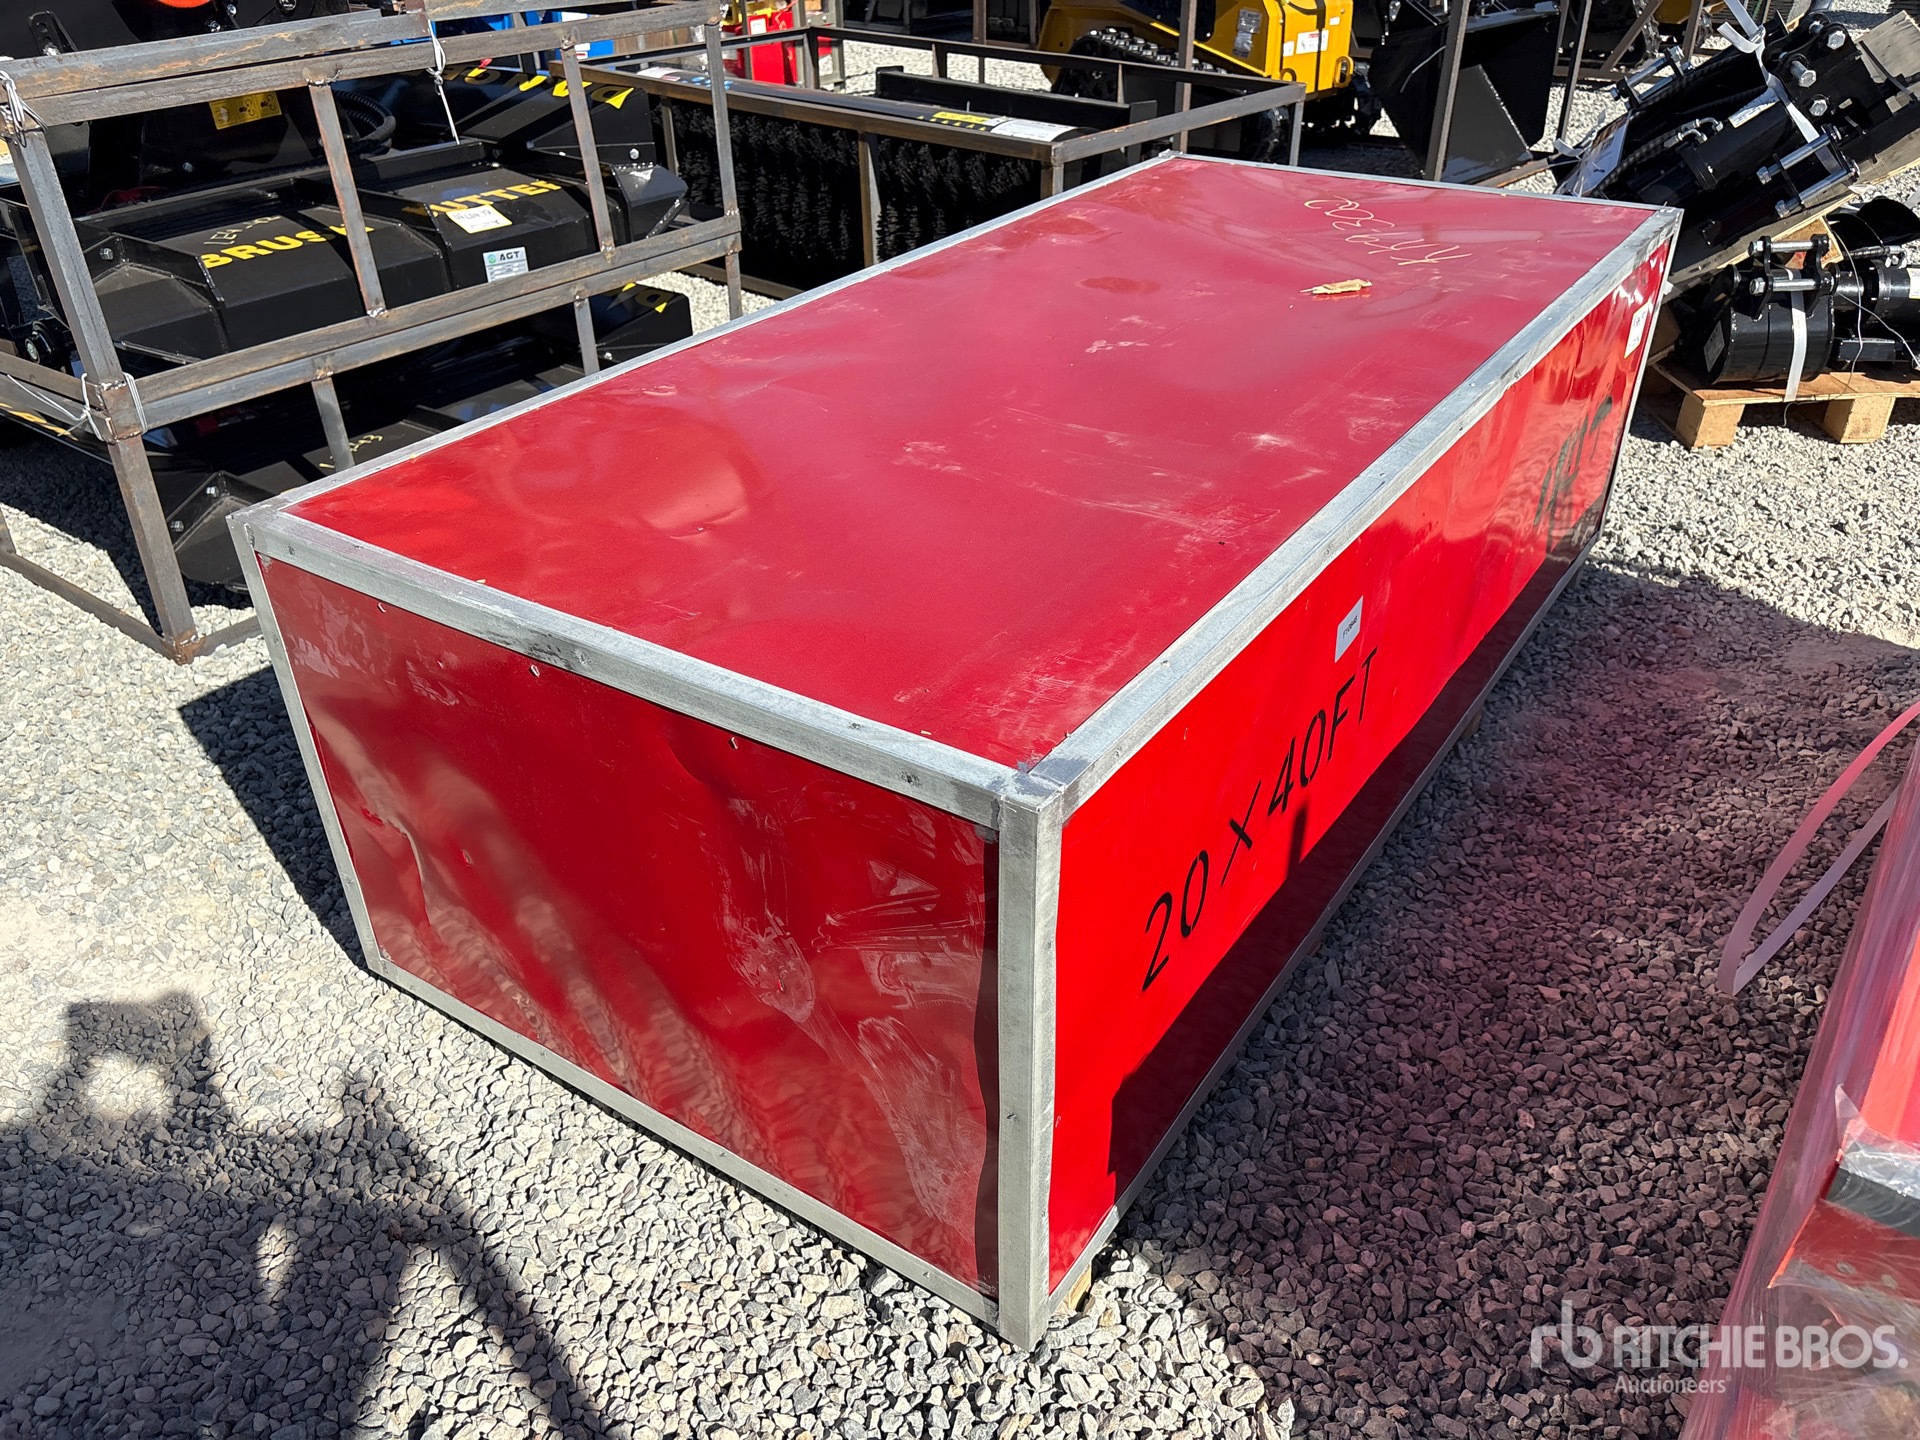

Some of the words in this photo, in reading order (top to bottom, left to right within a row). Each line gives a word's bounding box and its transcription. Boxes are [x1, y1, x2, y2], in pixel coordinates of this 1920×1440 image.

[499, 250, 521, 262] AGT
[1141, 849, 1209, 992] 20
[1267, 645, 1379, 818] 40FT
